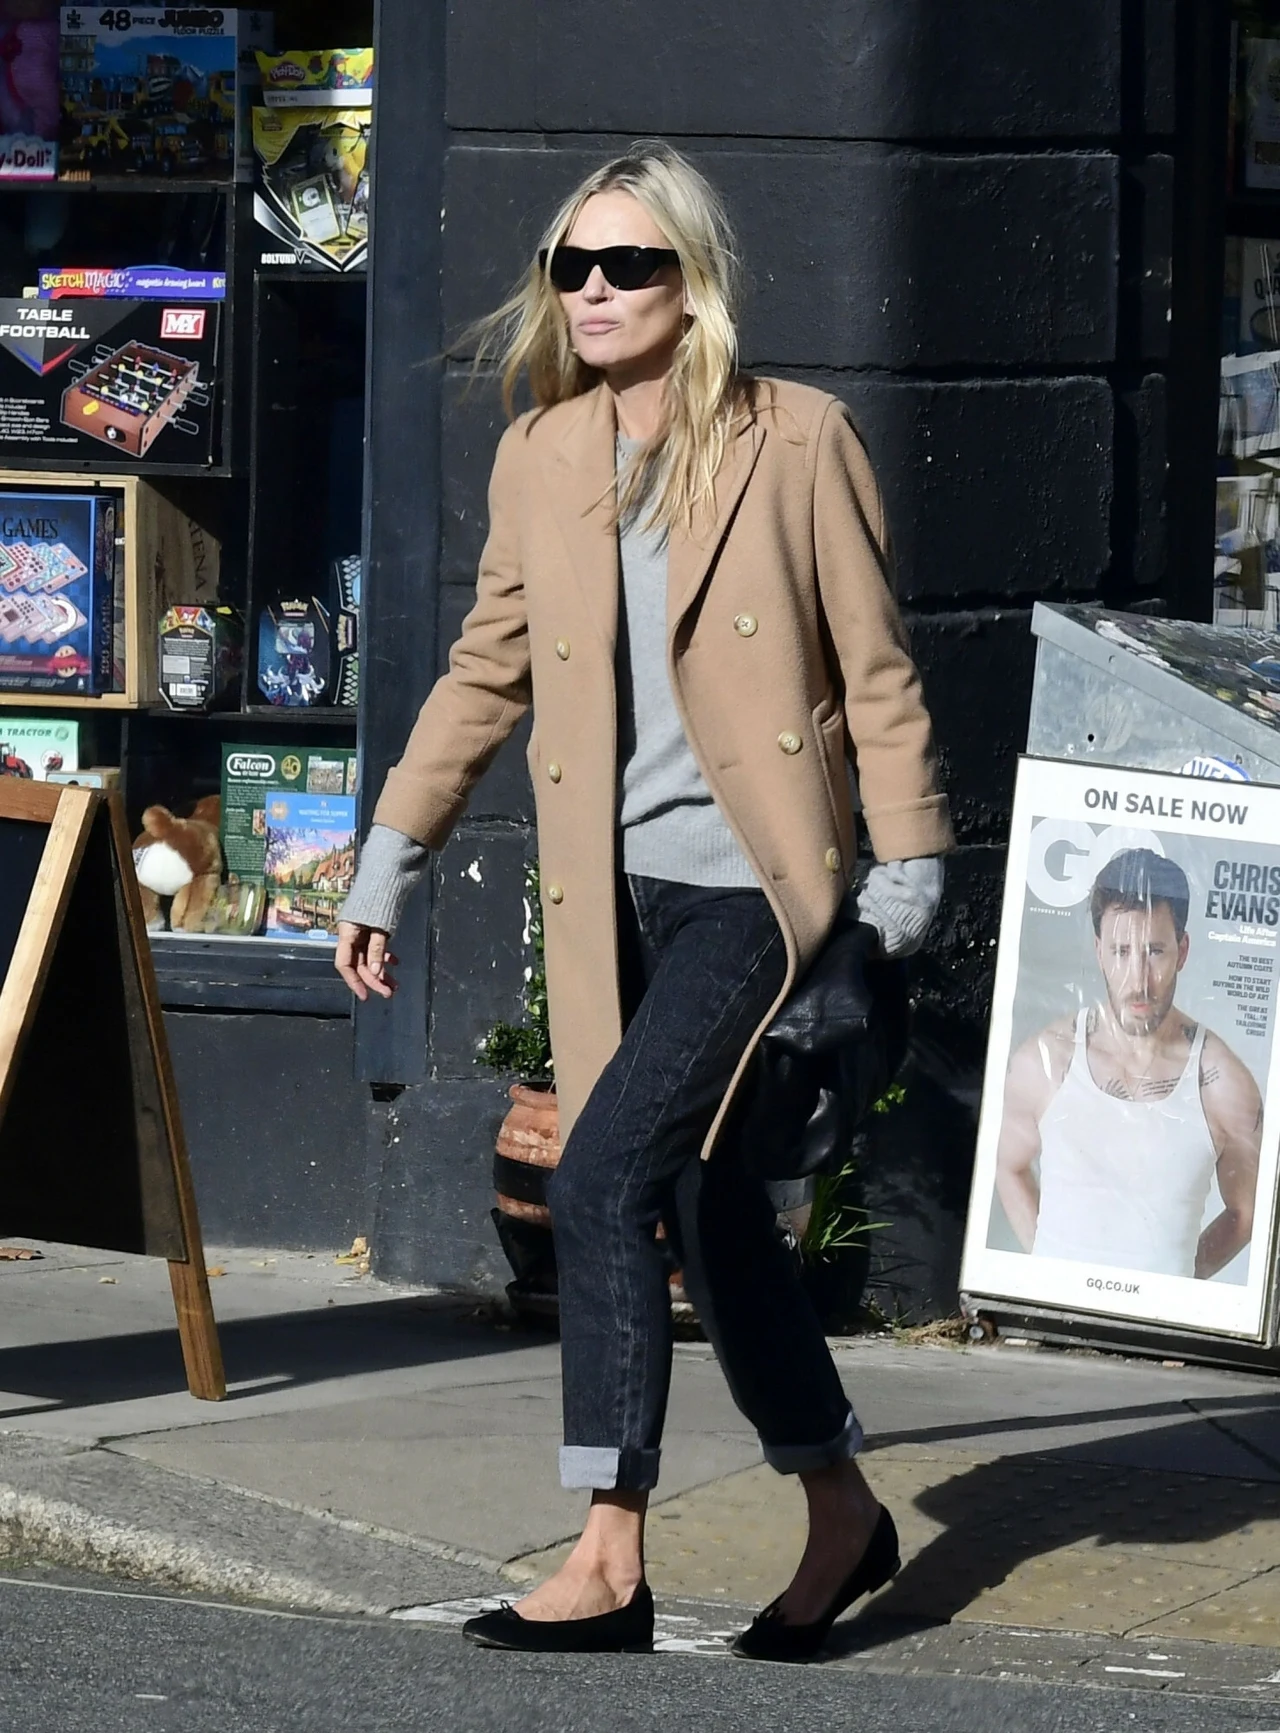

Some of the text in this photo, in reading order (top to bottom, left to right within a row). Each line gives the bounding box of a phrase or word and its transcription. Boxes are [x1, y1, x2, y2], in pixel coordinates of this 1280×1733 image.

[99, 9, 131, 31] 48
[132, 17, 155, 25] PIECE
[41, 273, 84, 290] SKETCH
[84, 271, 125, 293] MAGIC
[16, 308, 73, 322] TABLE
[0, 324, 91, 339] FOOTBALL
[2, 517, 59, 539] GAMES
[7, 728, 53, 737] TRACTOR
[233, 757, 270, 771] Falcon
[1084, 788, 1249, 825] ON SALE NOW
[1214, 860, 1280, 896] CHRIS
[1205, 890, 1280, 926] EVANS
[1240, 925, 1277, 937] Life After
[1208, 930, 1277, 947] Captain America
[1239, 954, 1250, 962] THE
[1258, 957, 1274, 965] BEST
[1226, 961, 1273, 973] AUTUMN COATS
[1228, 974, 1243, 982] HOW
[1252, 977, 1272, 985] START
[1212, 980, 1235, 989] BUYING
[1255, 986, 1271, 994] WILD
[1226, 989, 1248, 998] WORLD
[1257, 993, 1270, 1001] ART
[1237, 1003, 1248, 1011] THE
[1086, 1277, 1141, 1295] GQ.CO.UK
